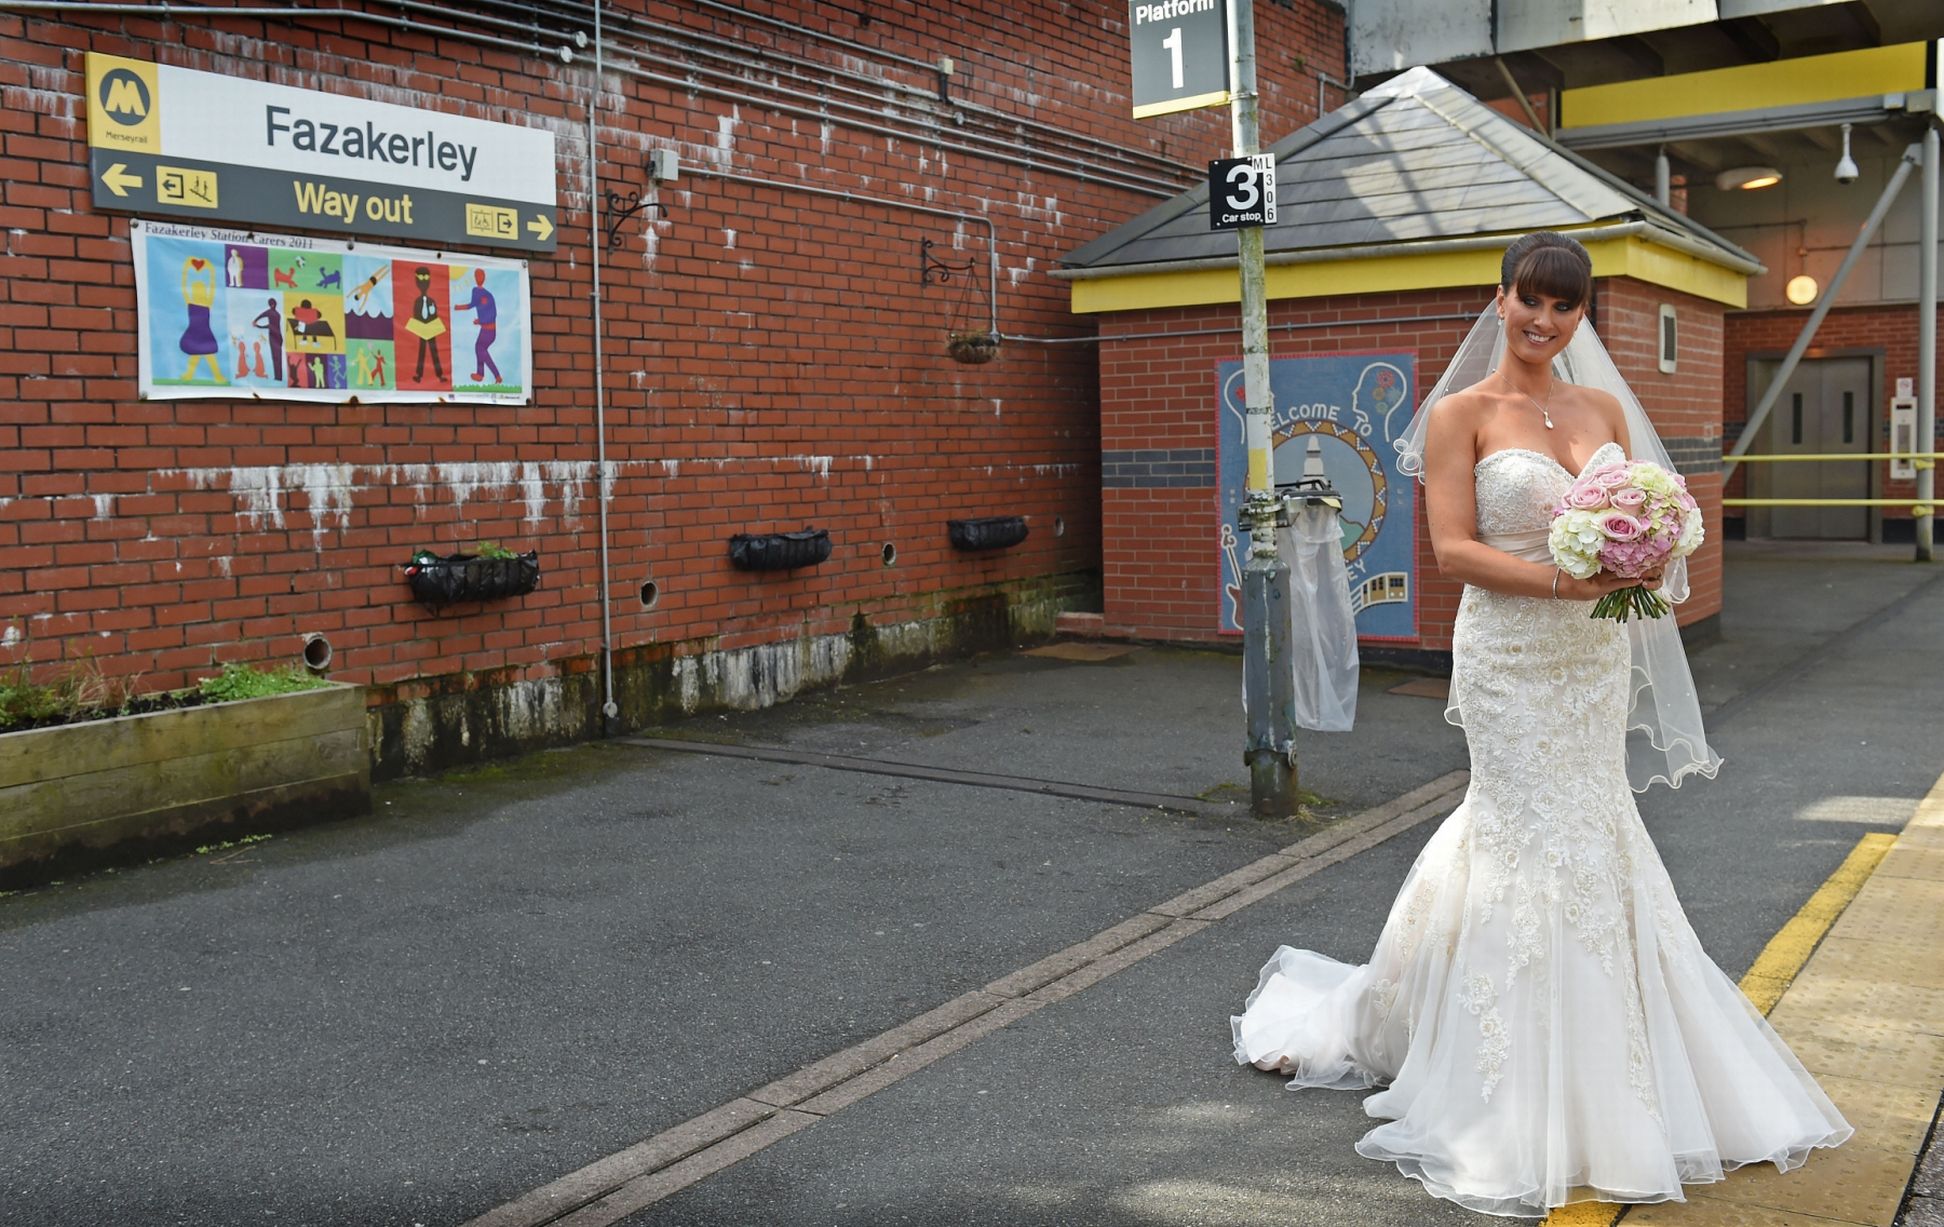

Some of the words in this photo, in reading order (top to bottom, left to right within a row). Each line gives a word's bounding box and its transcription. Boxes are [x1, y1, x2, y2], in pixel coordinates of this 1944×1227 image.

[1135, 0, 1215, 25] Platform
[1162, 27, 1184, 89] 1
[105, 130, 148, 143] Merseyrail
[266, 104, 478, 182] Fazakerley
[293, 181, 358, 223] Way
[365, 193, 413, 224] out
[1225, 164, 1260, 211] 3
[1222, 213, 1239, 223] Car
[1240, 212, 1261, 222] stop
[145, 222, 206, 240] Fazakerley
[210, 229, 249, 243] Station
[251, 234, 286, 247] Carers
[288, 237, 315, 249] 2011
[1271, 403, 1341, 432] ELCOME
[1353, 415, 1373, 437] TO
